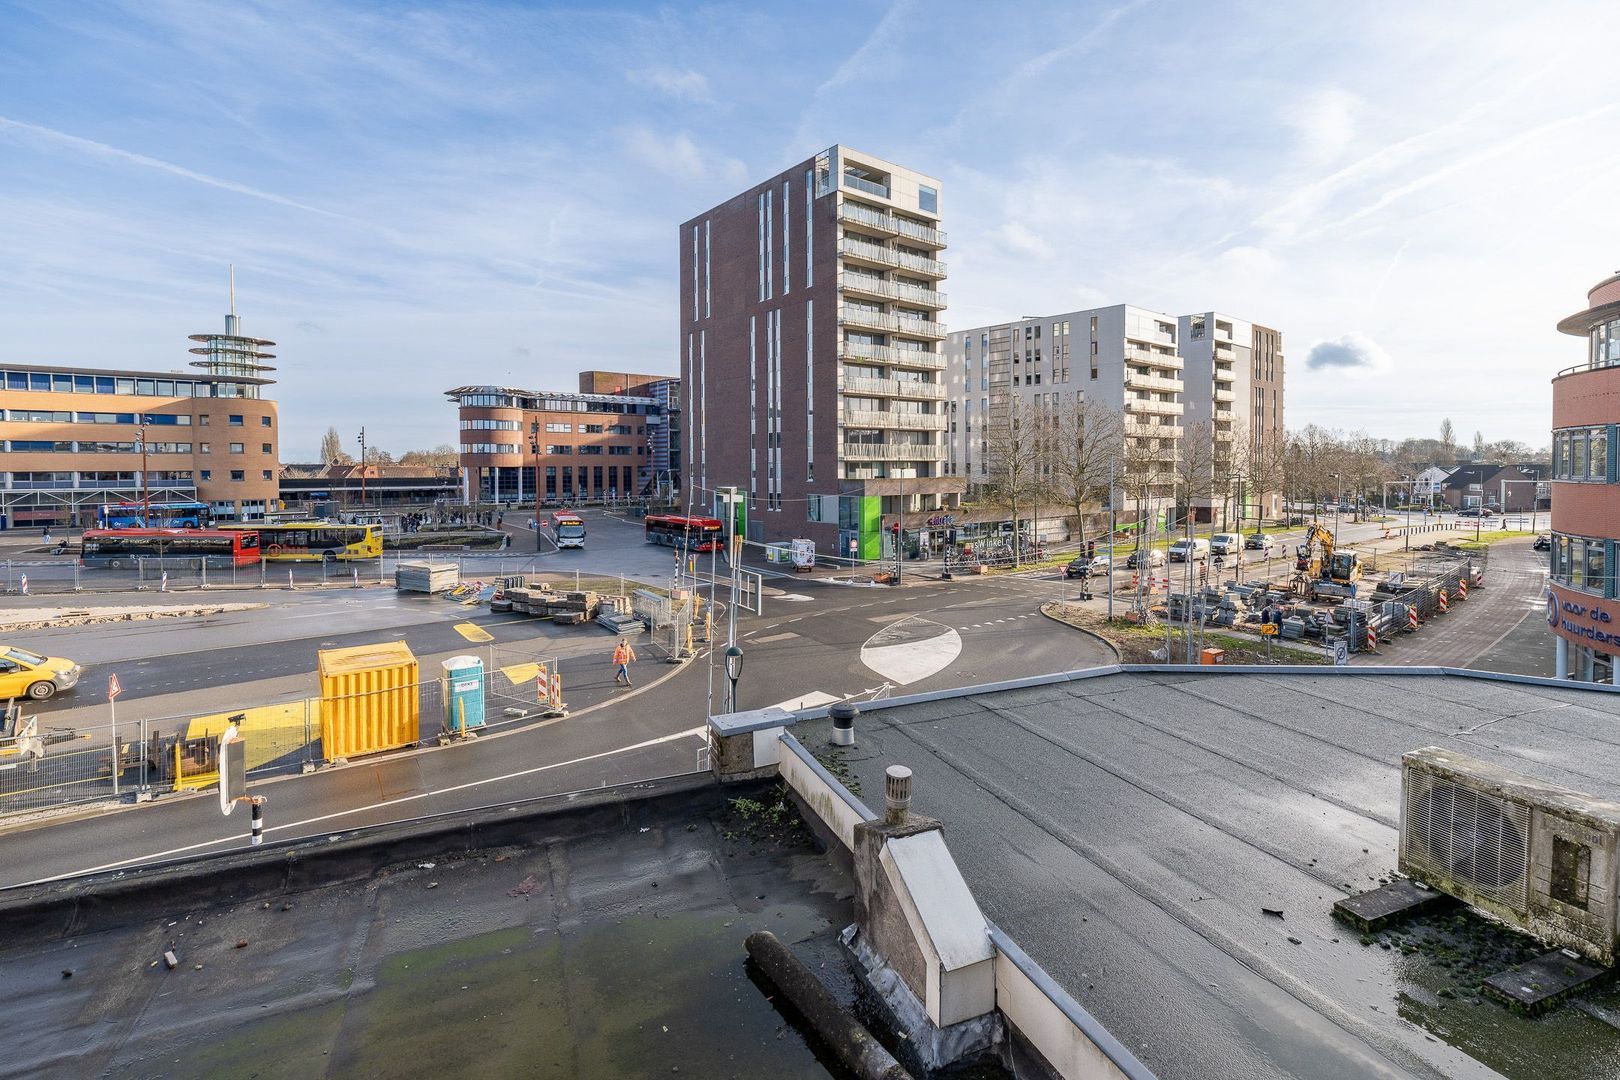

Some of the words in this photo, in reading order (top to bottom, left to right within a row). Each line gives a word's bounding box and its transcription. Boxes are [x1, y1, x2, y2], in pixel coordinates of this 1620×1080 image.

[1562, 601, 1587, 616] voor
[1590, 607, 1612, 623] de
[1562, 616, 1620, 646] huurders
